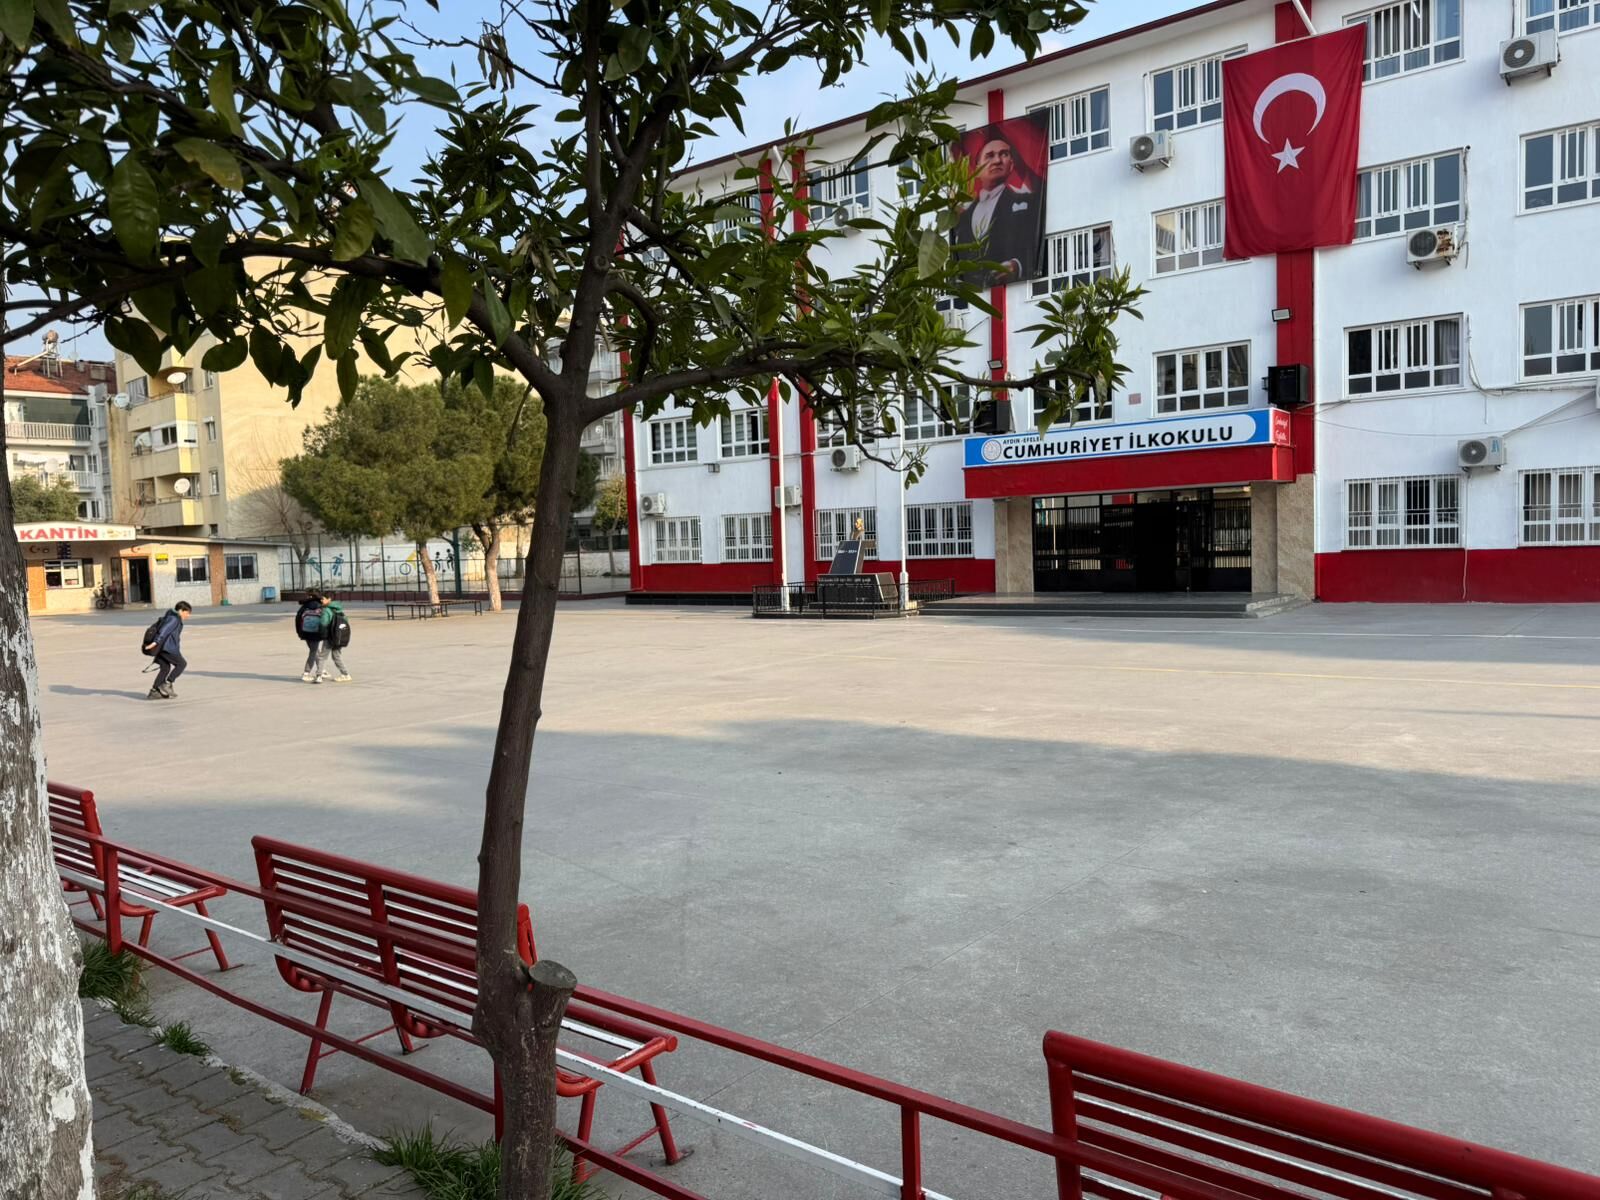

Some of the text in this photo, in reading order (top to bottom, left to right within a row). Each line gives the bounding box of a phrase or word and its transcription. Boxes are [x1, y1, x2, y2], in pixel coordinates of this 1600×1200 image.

[1003, 426, 1233, 459] CUMHURİYET İLKOKULU
[20, 526, 98, 539] KANTİN
